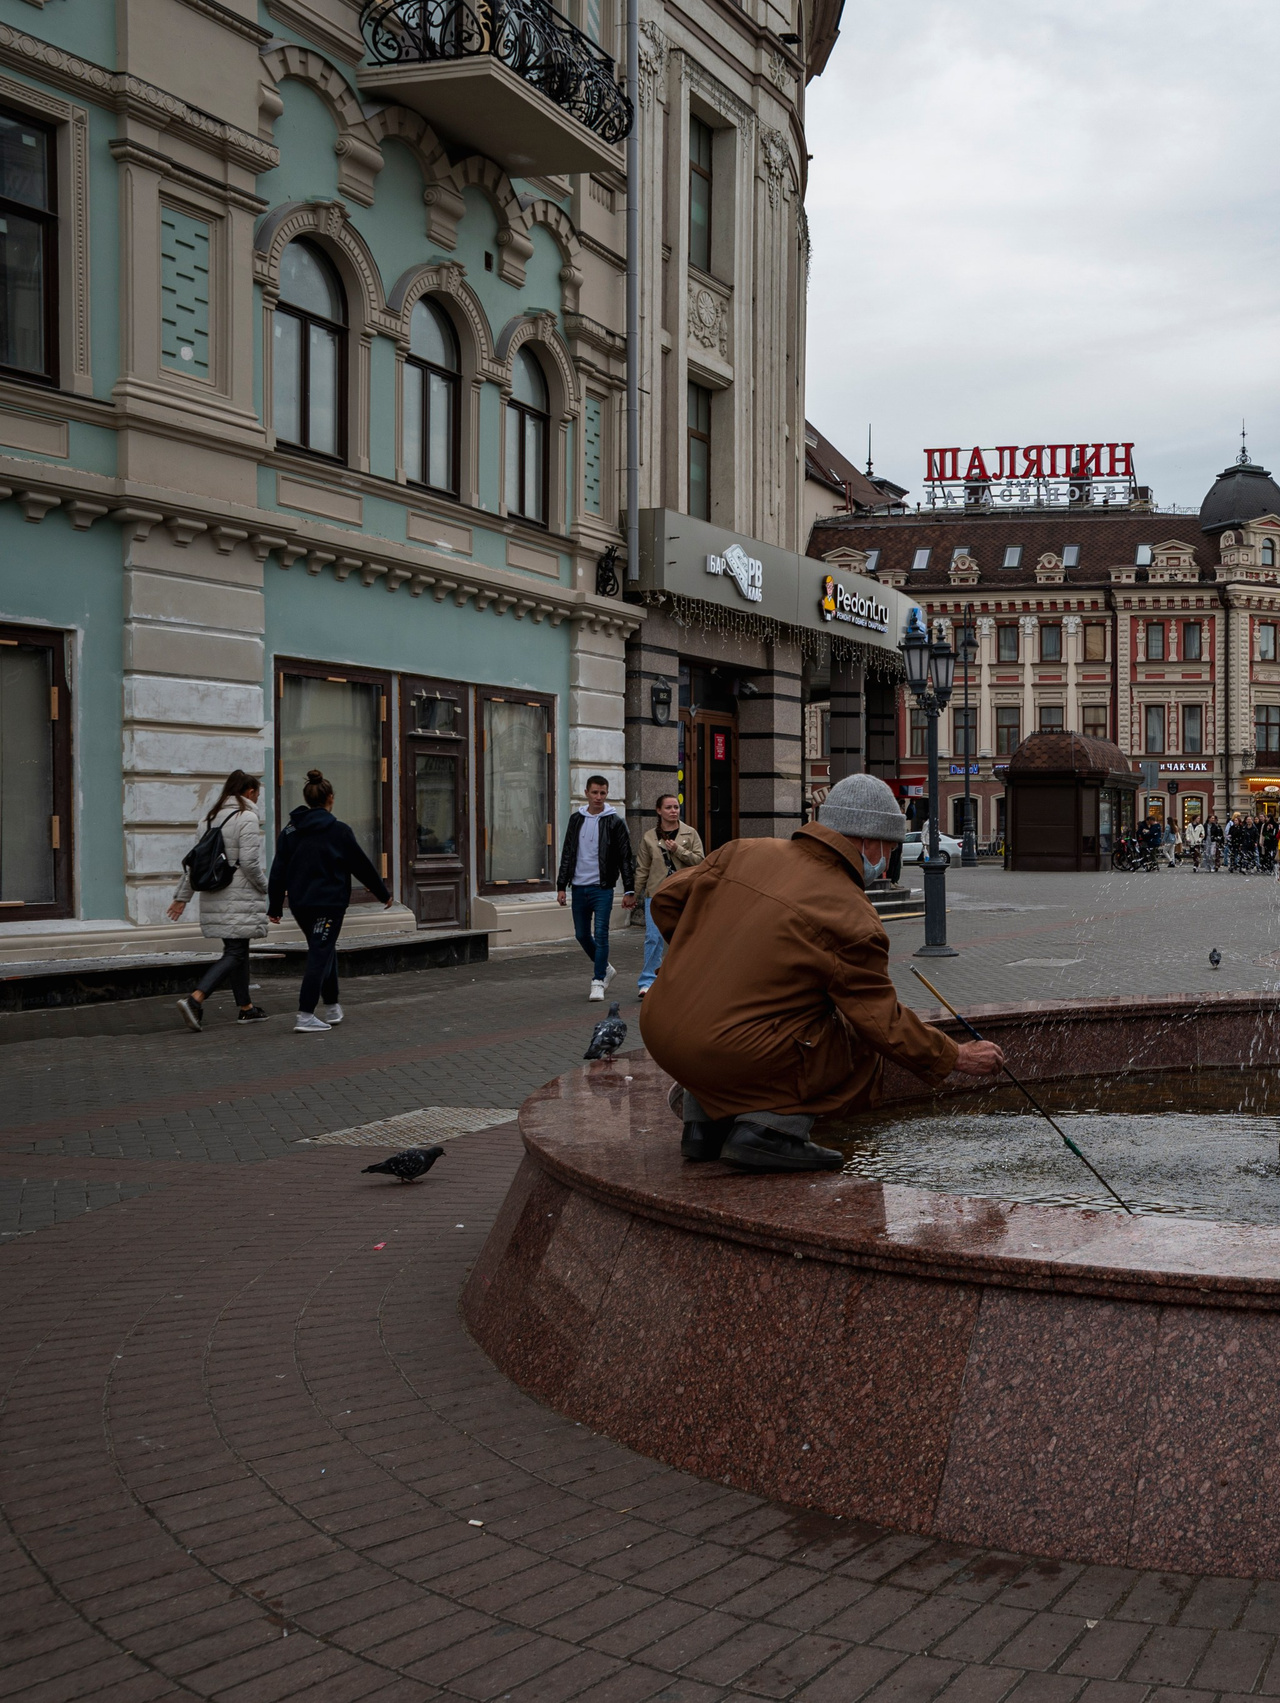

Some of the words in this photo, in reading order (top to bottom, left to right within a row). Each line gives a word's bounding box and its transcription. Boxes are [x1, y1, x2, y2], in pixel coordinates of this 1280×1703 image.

[923, 443, 1135, 481] ШАЛЯПИН
[925, 487, 1031, 506] PALACE
[1046, 485, 1135, 502] HOTEL
[707, 554, 727, 576] БАР
[837, 583, 889, 624] Pedant.ru
